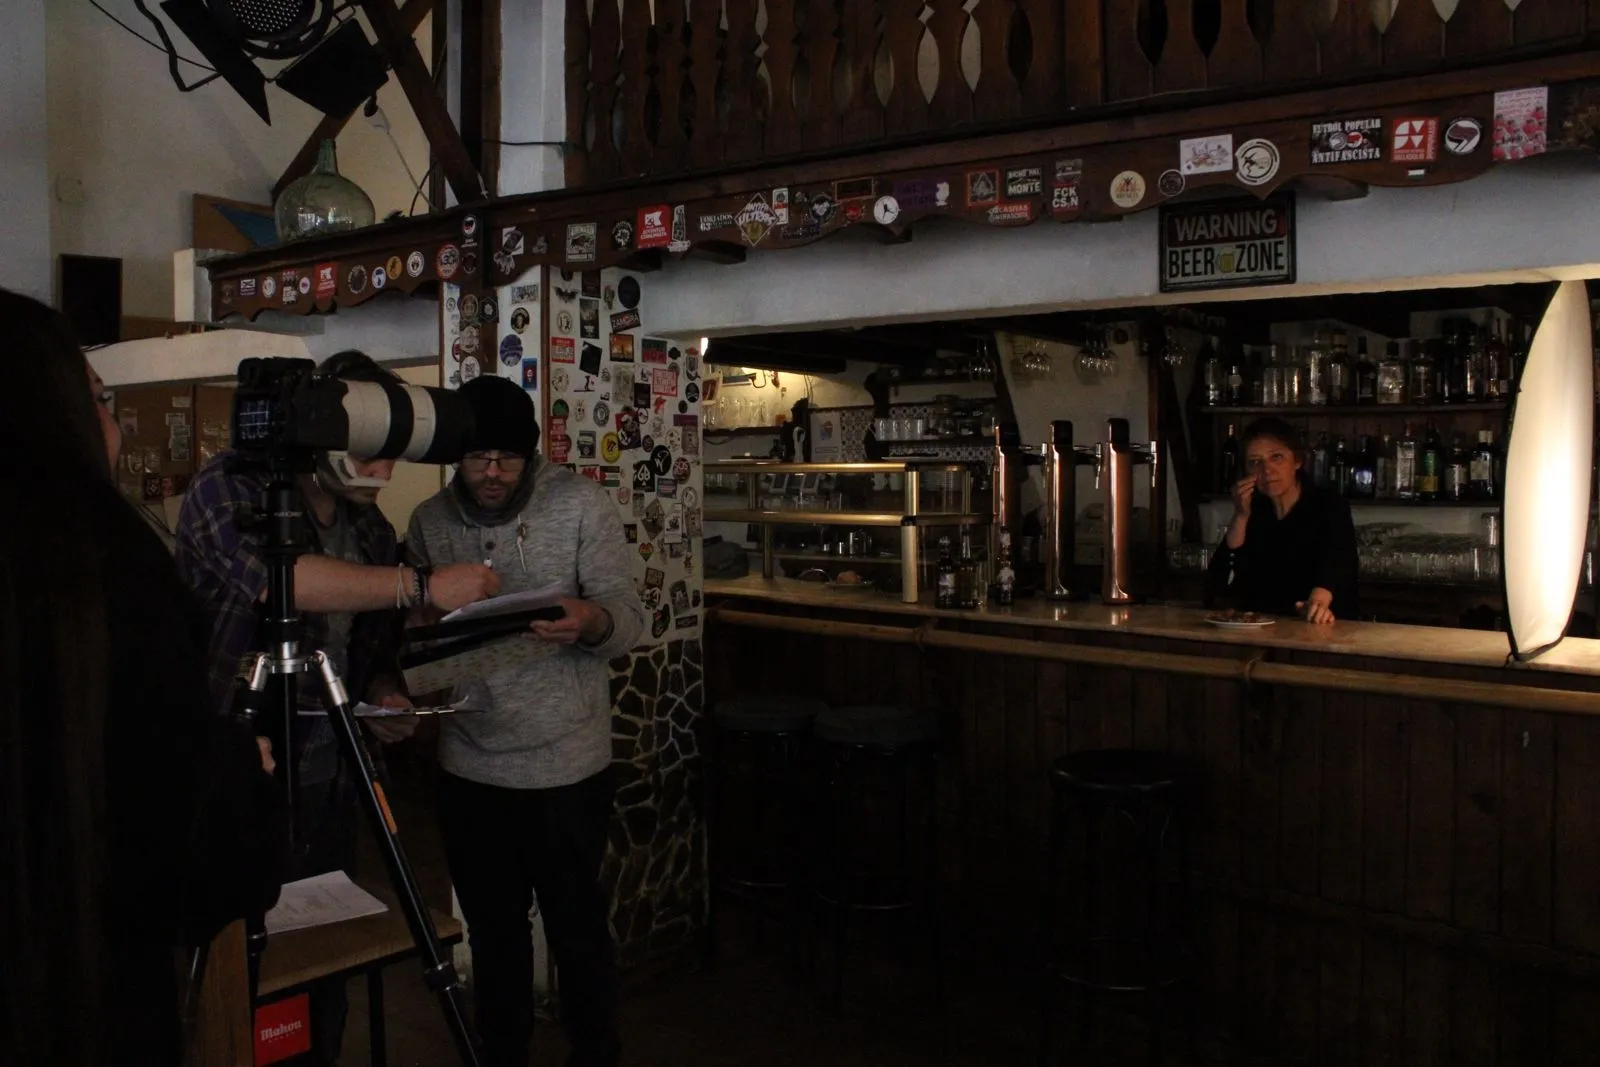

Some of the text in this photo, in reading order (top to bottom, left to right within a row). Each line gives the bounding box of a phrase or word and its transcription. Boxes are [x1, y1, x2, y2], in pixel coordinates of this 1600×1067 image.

[1345, 118, 1382, 131] POPULAR
[1311, 148, 1381, 164] ANTIFASCISTA
[1008, 182, 1041, 196] MONTE
[1054, 186, 1077, 198] FCK
[1175, 208, 1278, 242] WARNING
[1168, 240, 1285, 279] BEER ZONE
[260, 1020, 304, 1041] Mahou
